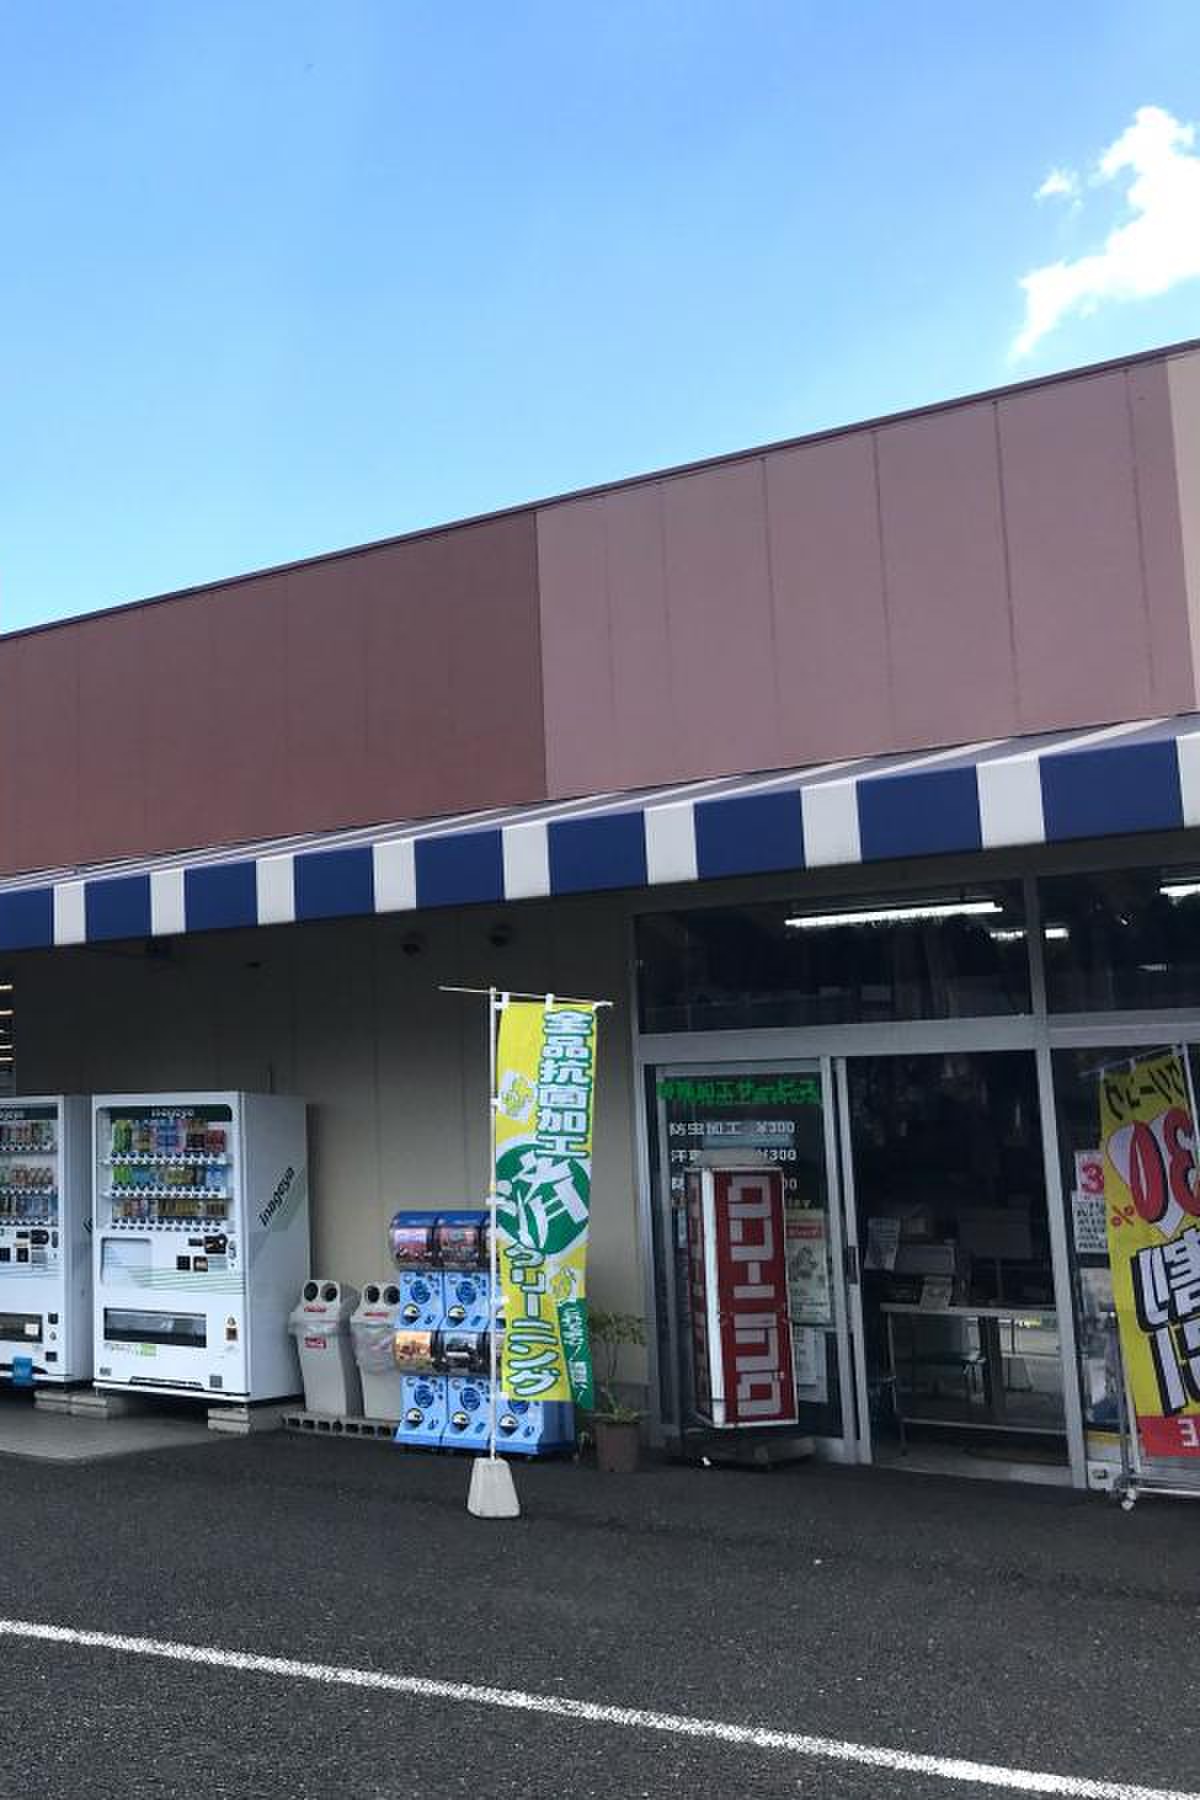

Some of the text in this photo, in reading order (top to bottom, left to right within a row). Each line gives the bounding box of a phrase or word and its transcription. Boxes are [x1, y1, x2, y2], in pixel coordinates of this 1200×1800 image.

[504, 1245, 561, 1397] クリーニング
